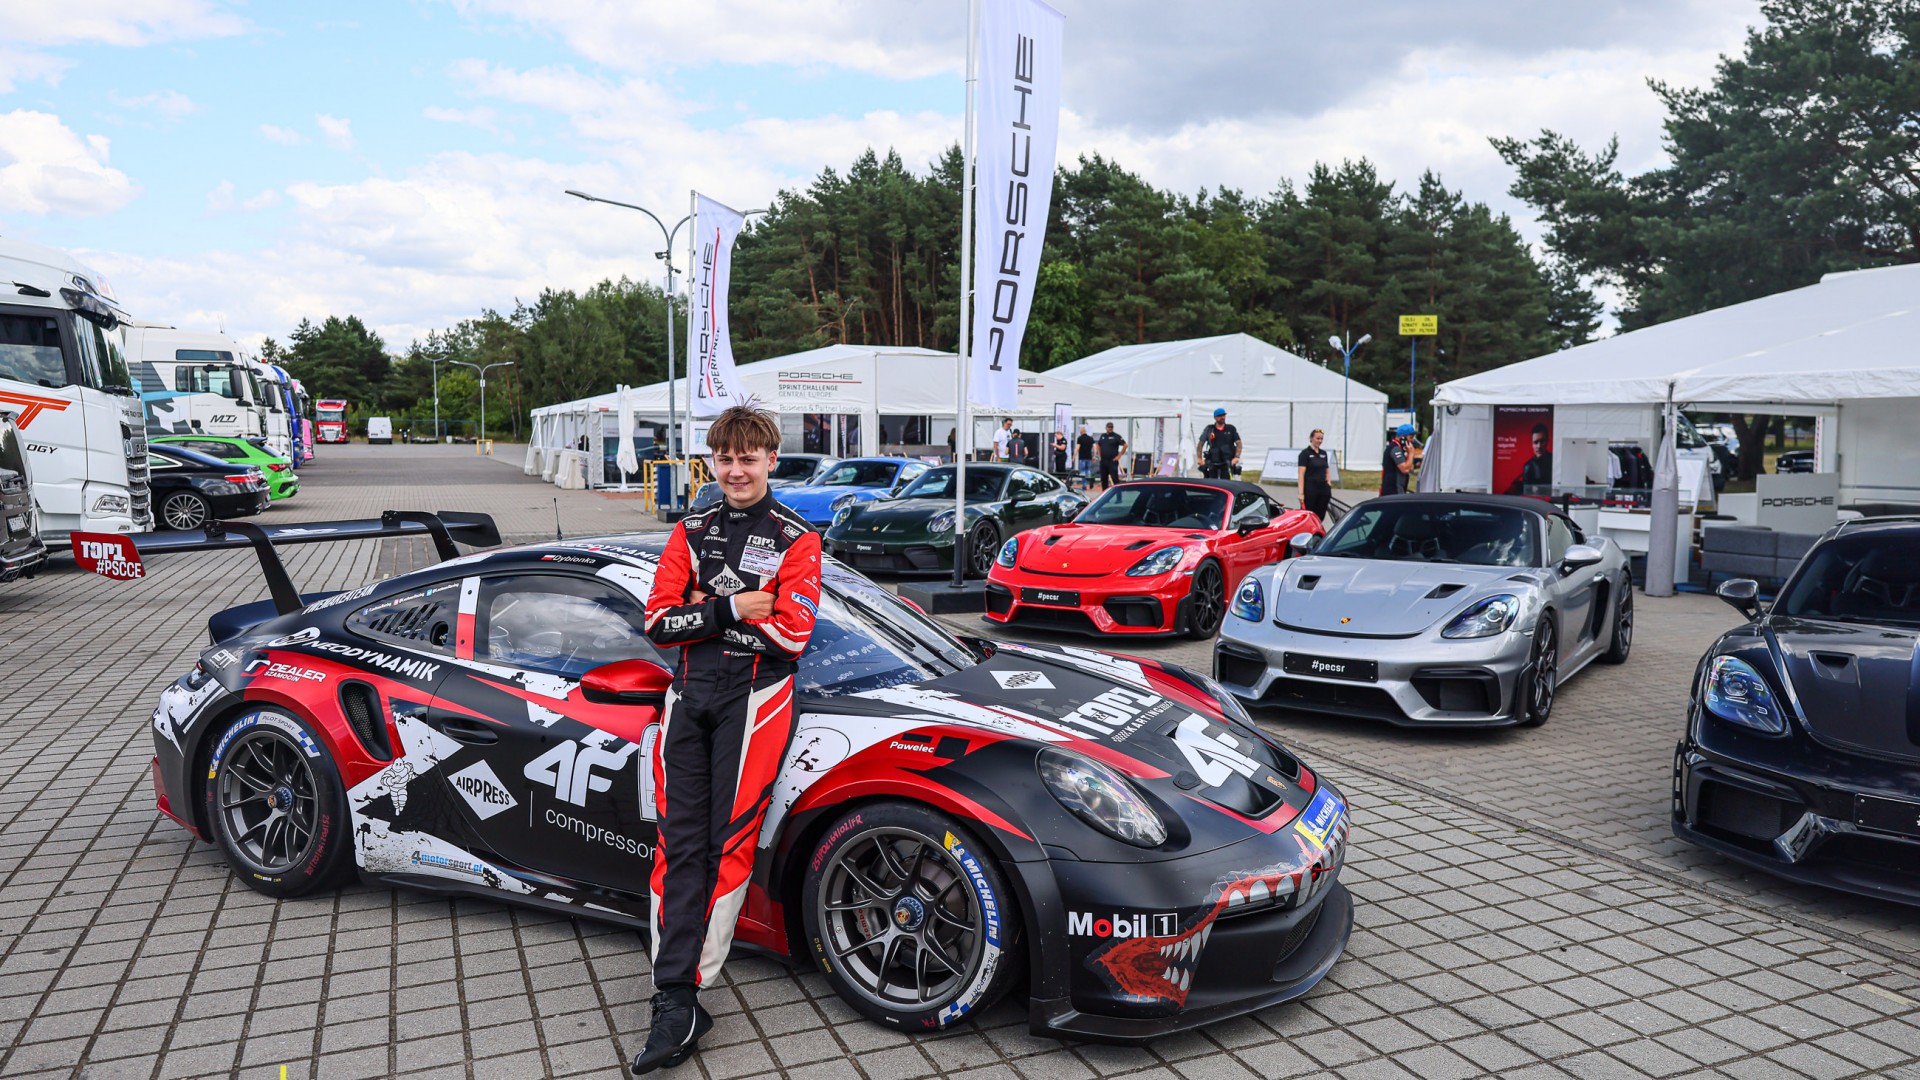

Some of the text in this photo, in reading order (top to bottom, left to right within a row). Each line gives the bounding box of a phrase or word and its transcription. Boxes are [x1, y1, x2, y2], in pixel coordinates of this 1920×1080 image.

[990, 33, 1033, 371] PORSCHE
[778, 371, 853, 380] PORSCHE
[1762, 496, 1834, 507] PORSCHE
[856, 543, 872, 551] #pecsr
[96, 559, 142, 578] #PSCCE
[553, 555, 597, 564] Dybionka
[1037, 592, 1060, 601] #pecsr
[302, 640, 440, 682] NEODYNAMIK
[1311, 659, 1346, 674] #pecsr
[268, 663, 327, 682] DEALER
[216, 714, 257, 755] MICHELIN
[277, 718, 296, 731] SPORT
[889, 740, 935, 754] Pawelec
[523, 739, 633, 807] 4F
[455, 775, 511, 806] AIRPRESS
[1315, 796, 1336, 828] MICHELIN
[545, 807, 657, 861] compressor
[411, 850, 483, 872] 4motorsport.pl
[963, 858, 998, 940] MICHELIN
[1067, 911, 1147, 938] Mobil
